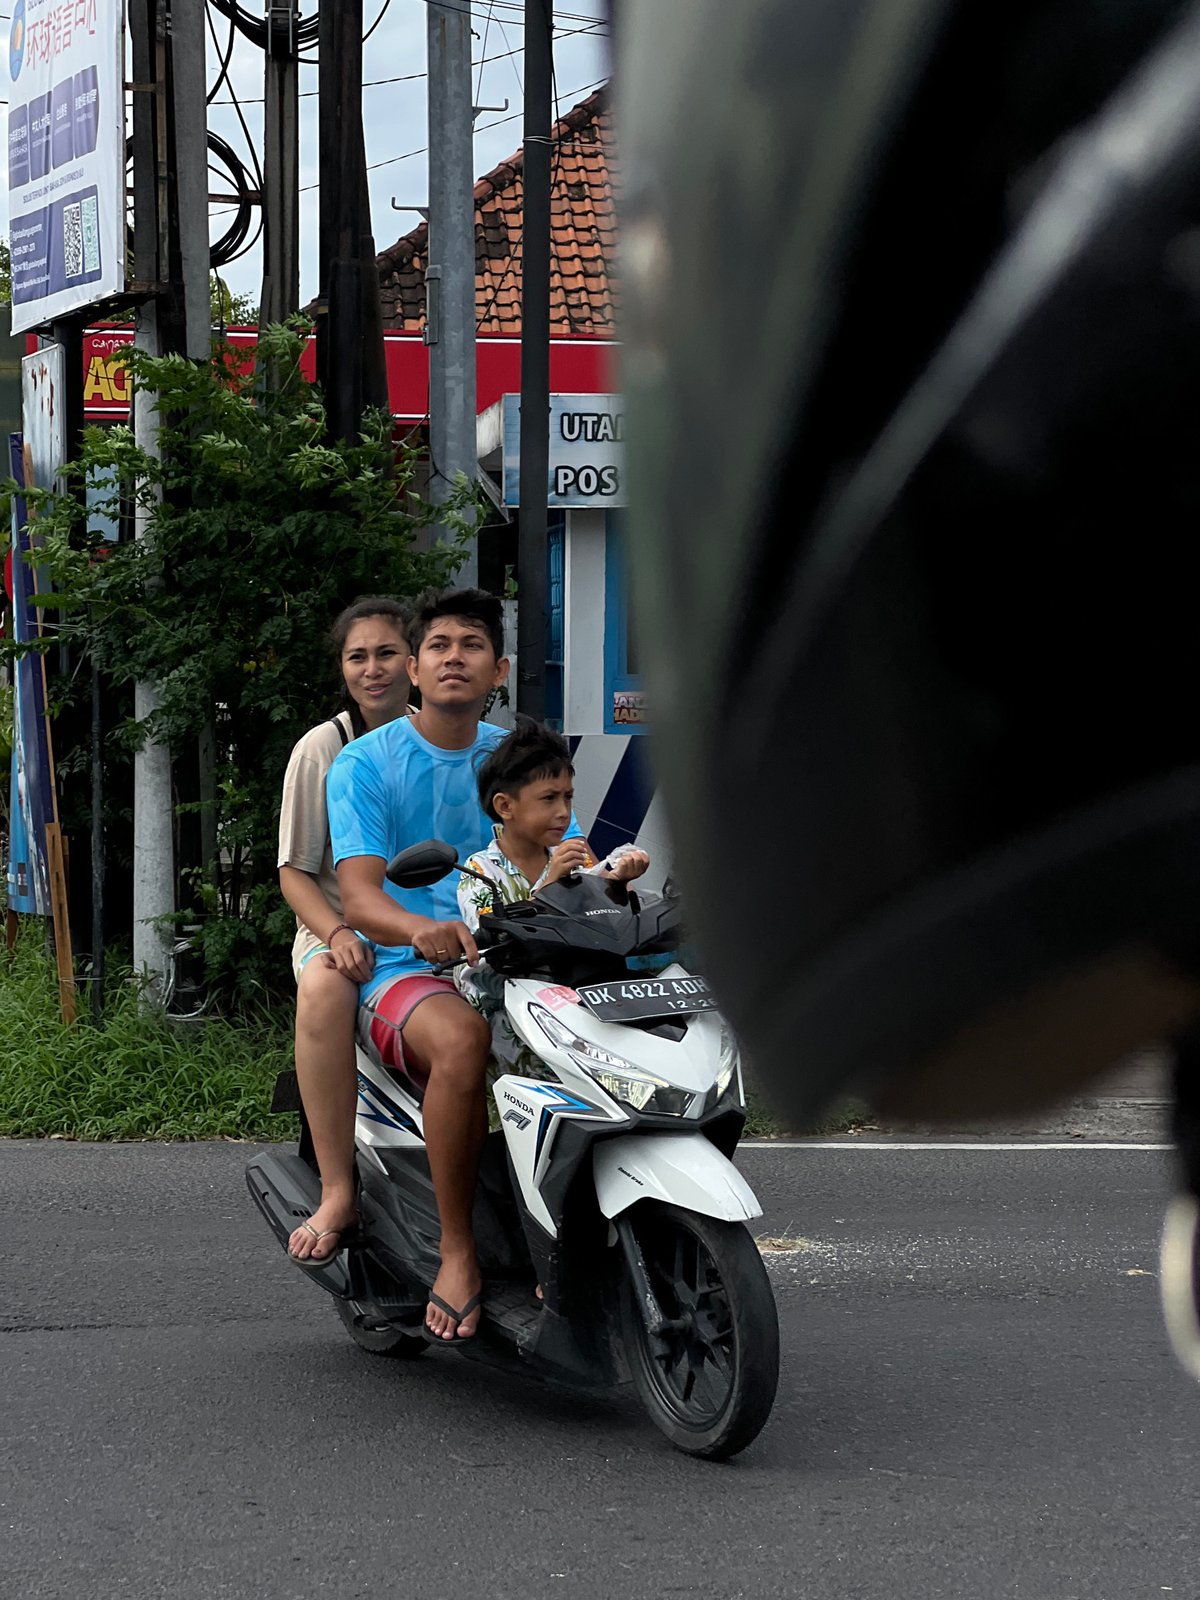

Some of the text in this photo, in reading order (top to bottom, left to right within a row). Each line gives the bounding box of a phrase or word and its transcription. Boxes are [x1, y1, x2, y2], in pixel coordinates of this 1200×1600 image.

[556, 466, 618, 495] POS
[584, 908, 621, 916] HONDA
[584, 987, 616, 1005] DK
[621, 983, 670, 1000] 4822
[503, 1091, 535, 1117] HONDA
